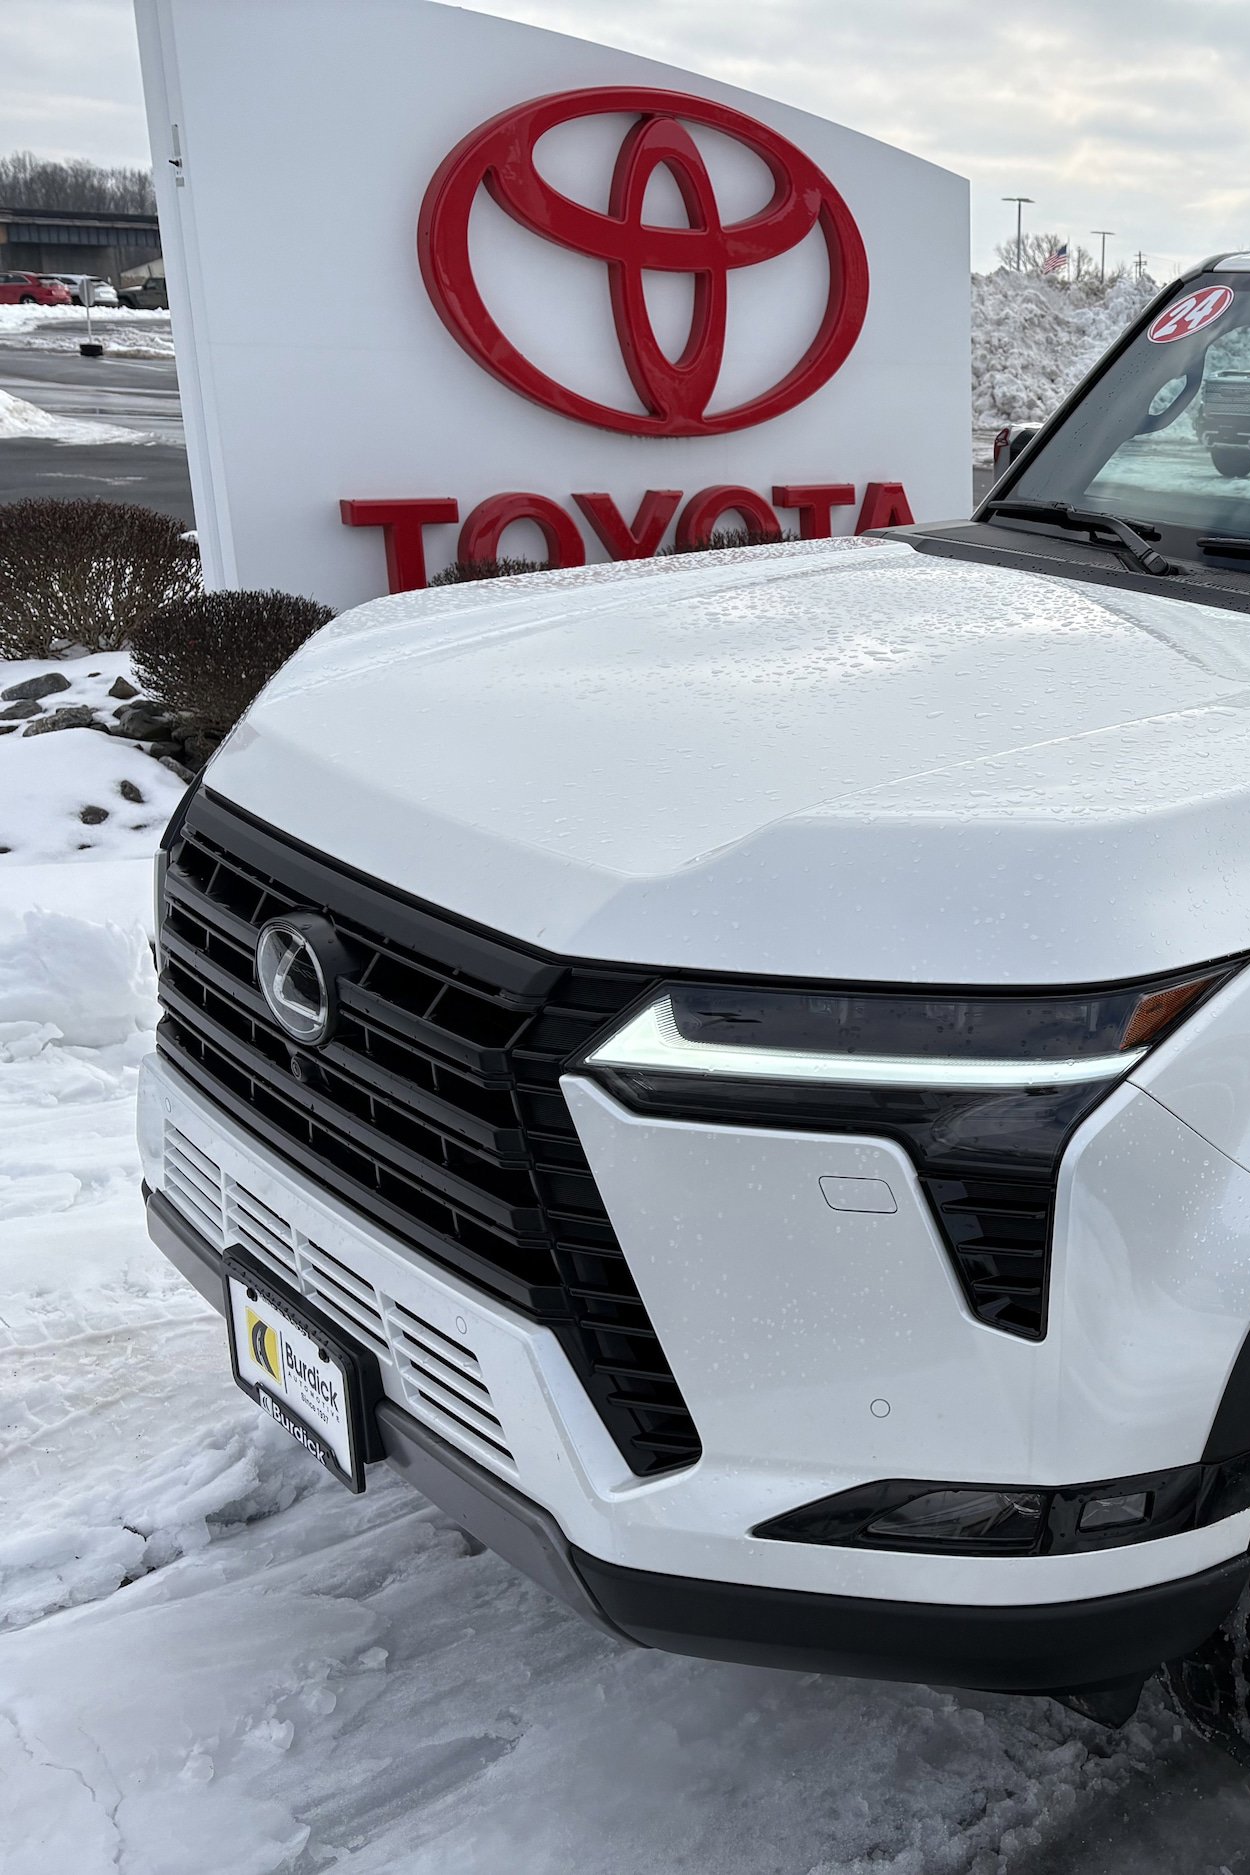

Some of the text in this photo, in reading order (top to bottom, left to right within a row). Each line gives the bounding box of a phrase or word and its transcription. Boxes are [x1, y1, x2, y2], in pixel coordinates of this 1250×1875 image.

[1152, 289, 1226, 340] 24
[340, 482, 916, 595] TOYOTA
[285, 1341, 339, 1412] Burdick
[288, 1371, 340, 1423] AUTOMOTIVE
[272, 1401, 326, 1466] Burdick
